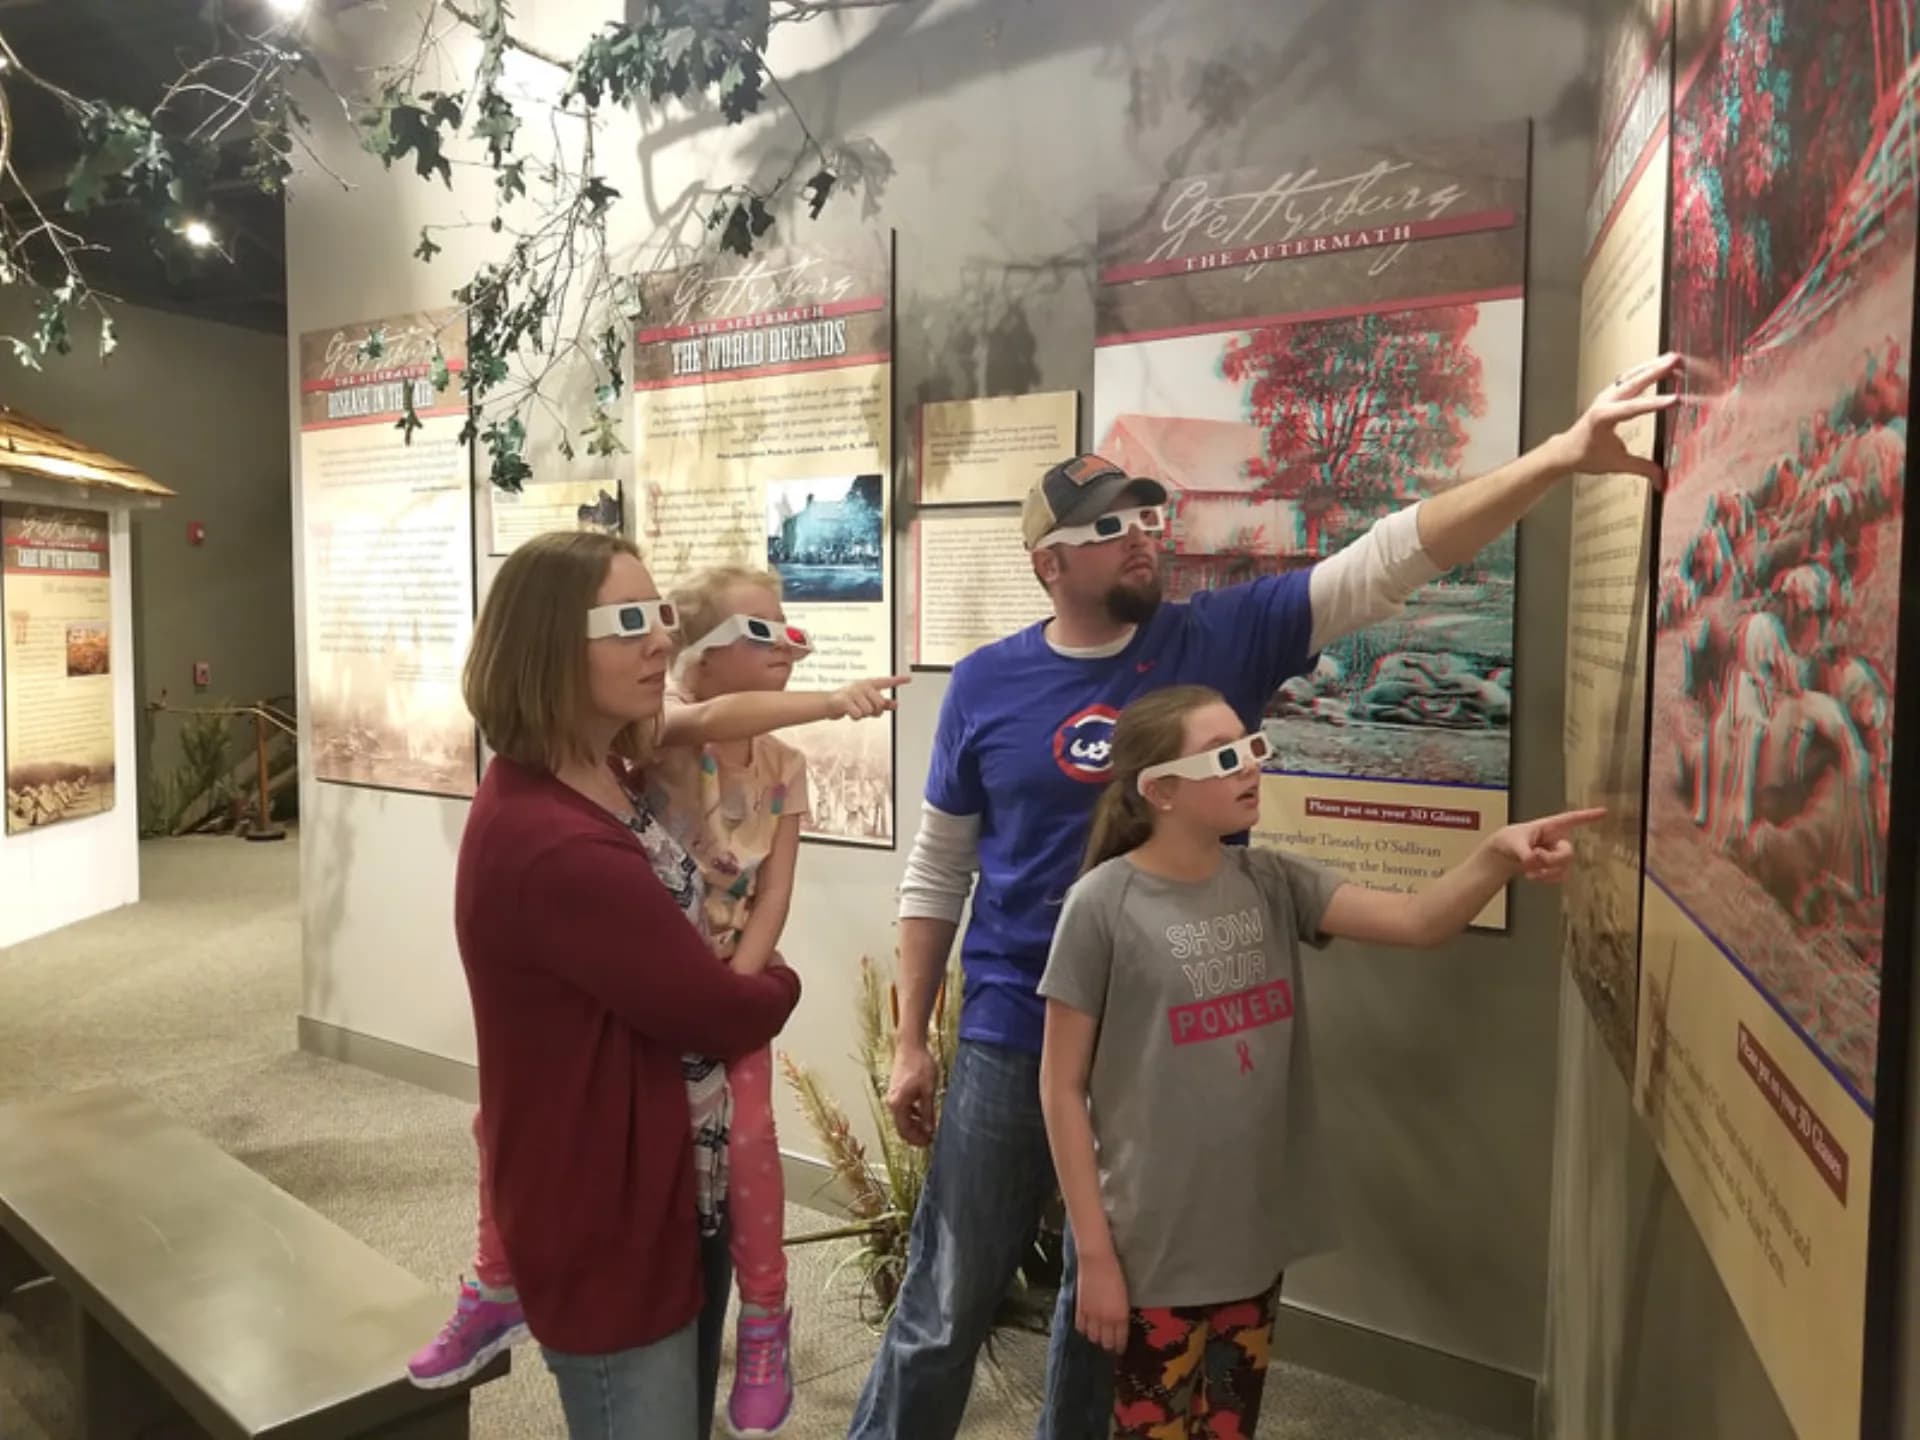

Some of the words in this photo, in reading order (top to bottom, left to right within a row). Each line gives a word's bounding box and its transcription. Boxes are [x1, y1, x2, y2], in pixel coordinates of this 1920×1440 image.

[1144, 160, 1466, 280] Gettysburg
[1184, 251, 1232, 272] THE
[1245, 225, 1412, 264] AFTERMATH
[690, 322, 718, 336] THE
[726, 305, 825, 332] AFTERMATH
[672, 339, 702, 375] THE
[707, 331, 764, 371] WORLD
[1310, 800, 1340, 814] Please
[1343, 804, 1362, 817] put
[1364, 807, 1379, 816] on
[1382, 808, 1407, 821] your
[1409, 808, 1428, 821] 3D
[1430, 810, 1473, 825] Glasses
[1318, 832, 1371, 854] Timothy
[1375, 838, 1441, 857] O'Sullivan
[1360, 859, 1378, 872] the
[1382, 860, 1428, 877] horrors
[1166, 907, 1264, 959] SHOW
[1182, 949, 1266, 999] YOUR
[1176, 988, 1288, 1040] POWER
